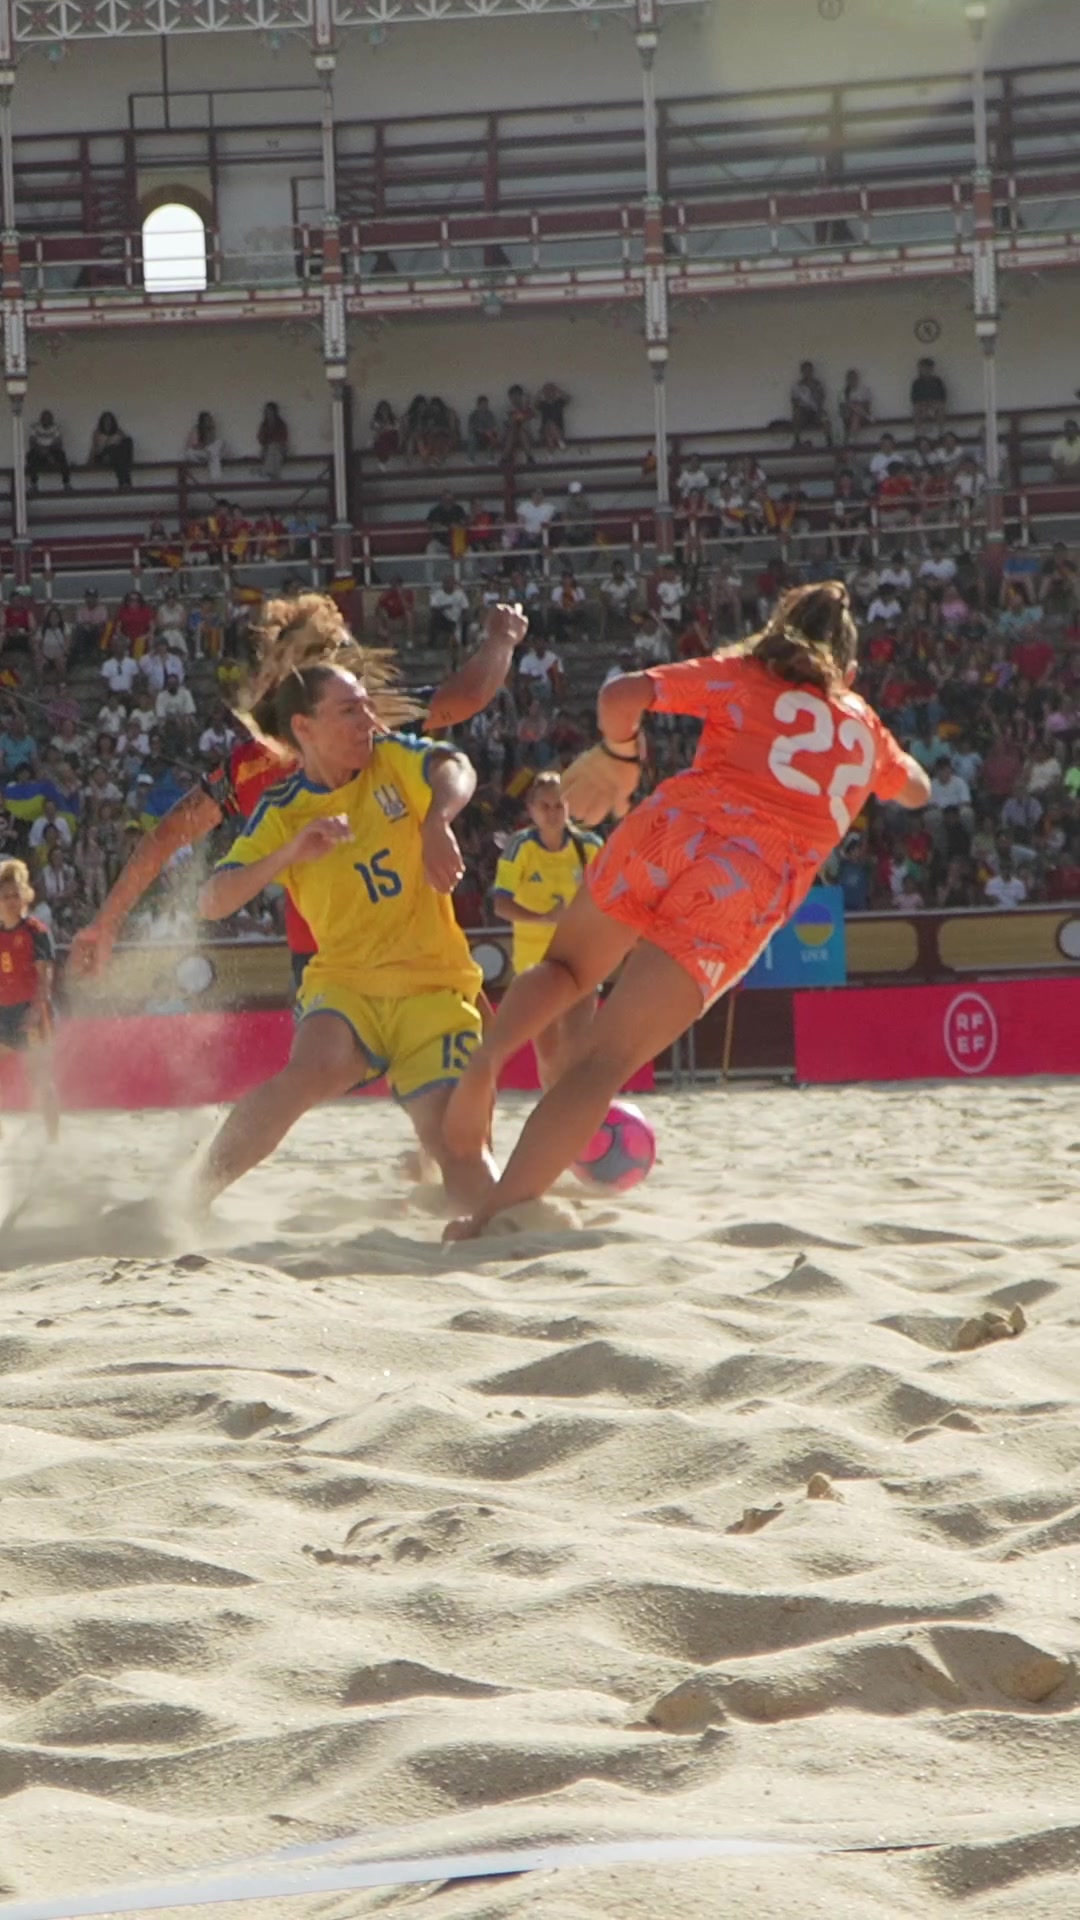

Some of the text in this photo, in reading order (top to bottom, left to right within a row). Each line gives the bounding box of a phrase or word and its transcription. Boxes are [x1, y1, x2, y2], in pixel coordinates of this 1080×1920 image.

[768, 690, 874, 838] 22
[353, 848, 402, 904] 15
[957, 1012, 984, 1031] RF
[442, 1030, 478, 1070] 15
[957, 1035, 986, 1054] EF
